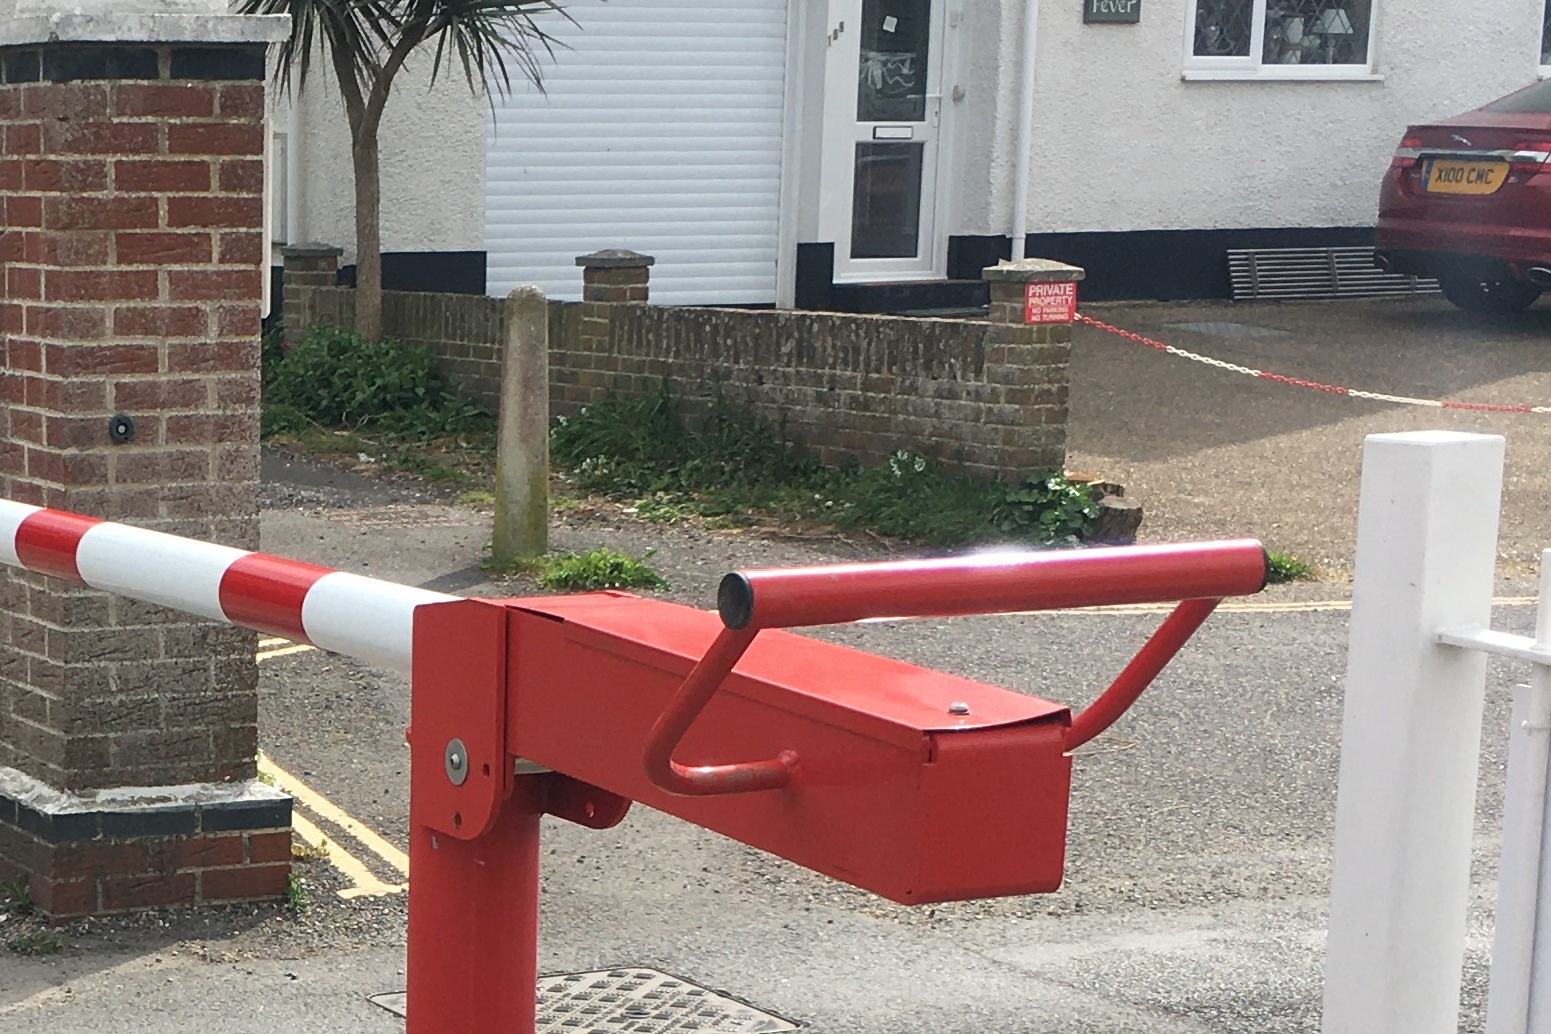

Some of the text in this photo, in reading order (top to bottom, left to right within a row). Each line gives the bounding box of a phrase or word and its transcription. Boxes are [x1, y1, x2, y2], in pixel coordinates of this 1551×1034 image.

[1435, 166, 1494, 185] X100 CMC
[1029, 283, 1074, 297] PRIVATE
[1028, 295, 1073, 308] PROPERTY
